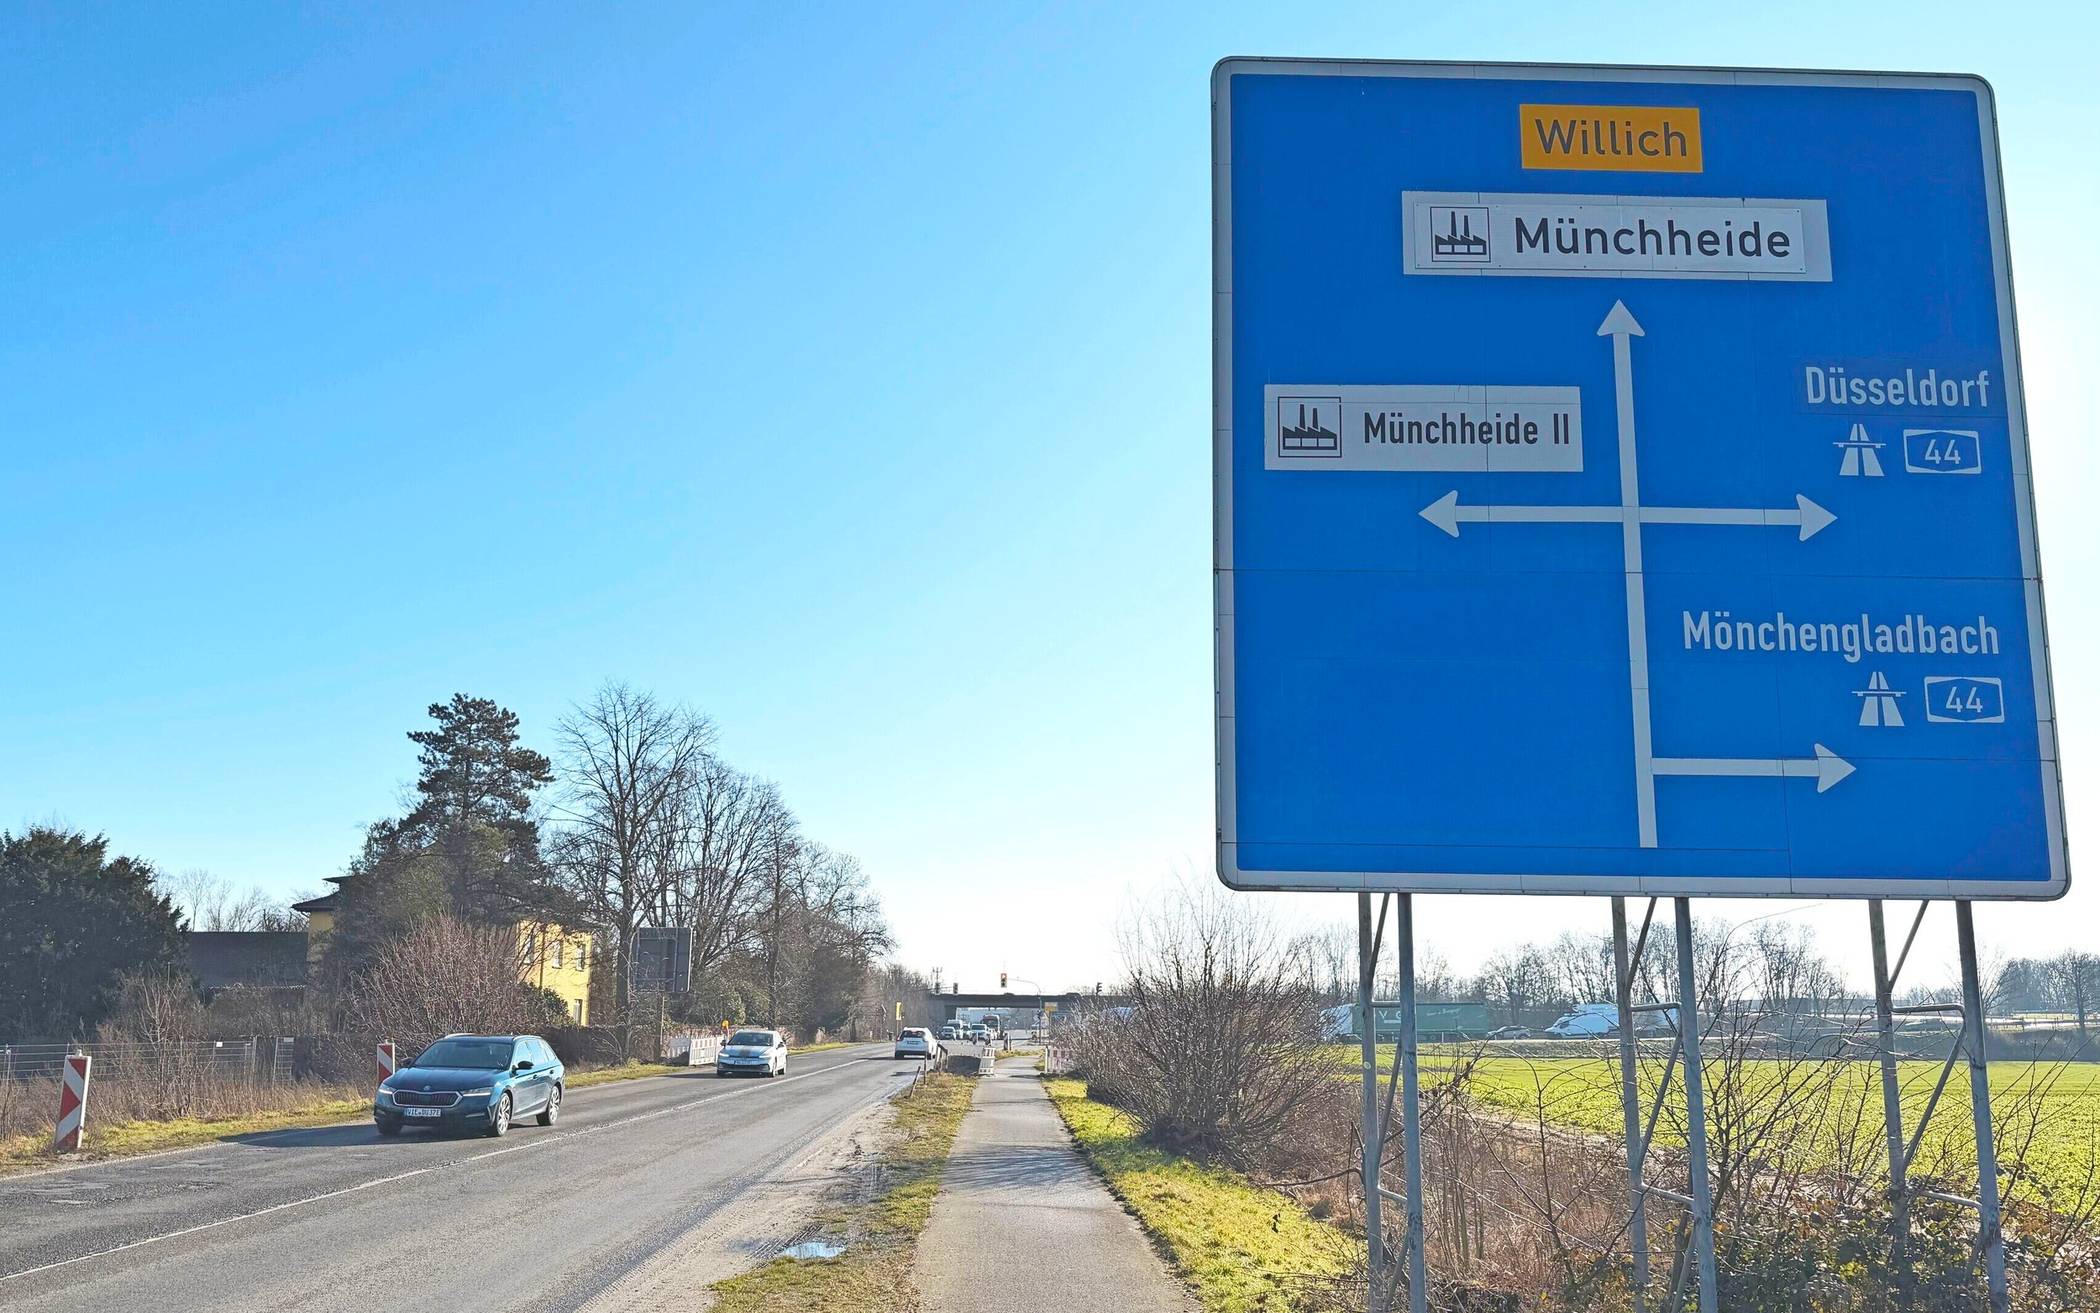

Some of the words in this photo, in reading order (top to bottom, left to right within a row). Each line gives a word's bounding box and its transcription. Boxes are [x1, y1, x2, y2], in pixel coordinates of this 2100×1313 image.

[1534, 118, 1687, 157] Willich
[1515, 217, 1790, 258] Münchheide
[1806, 366, 1989, 407] Düsseldorf
[1364, 411, 1538, 446] Münchheide
[1553, 412, 1570, 445] II
[1925, 439, 1961, 464] 44
[1683, 611, 1999, 663] Mönchengladbach
[1946, 686, 1983, 713] 44
